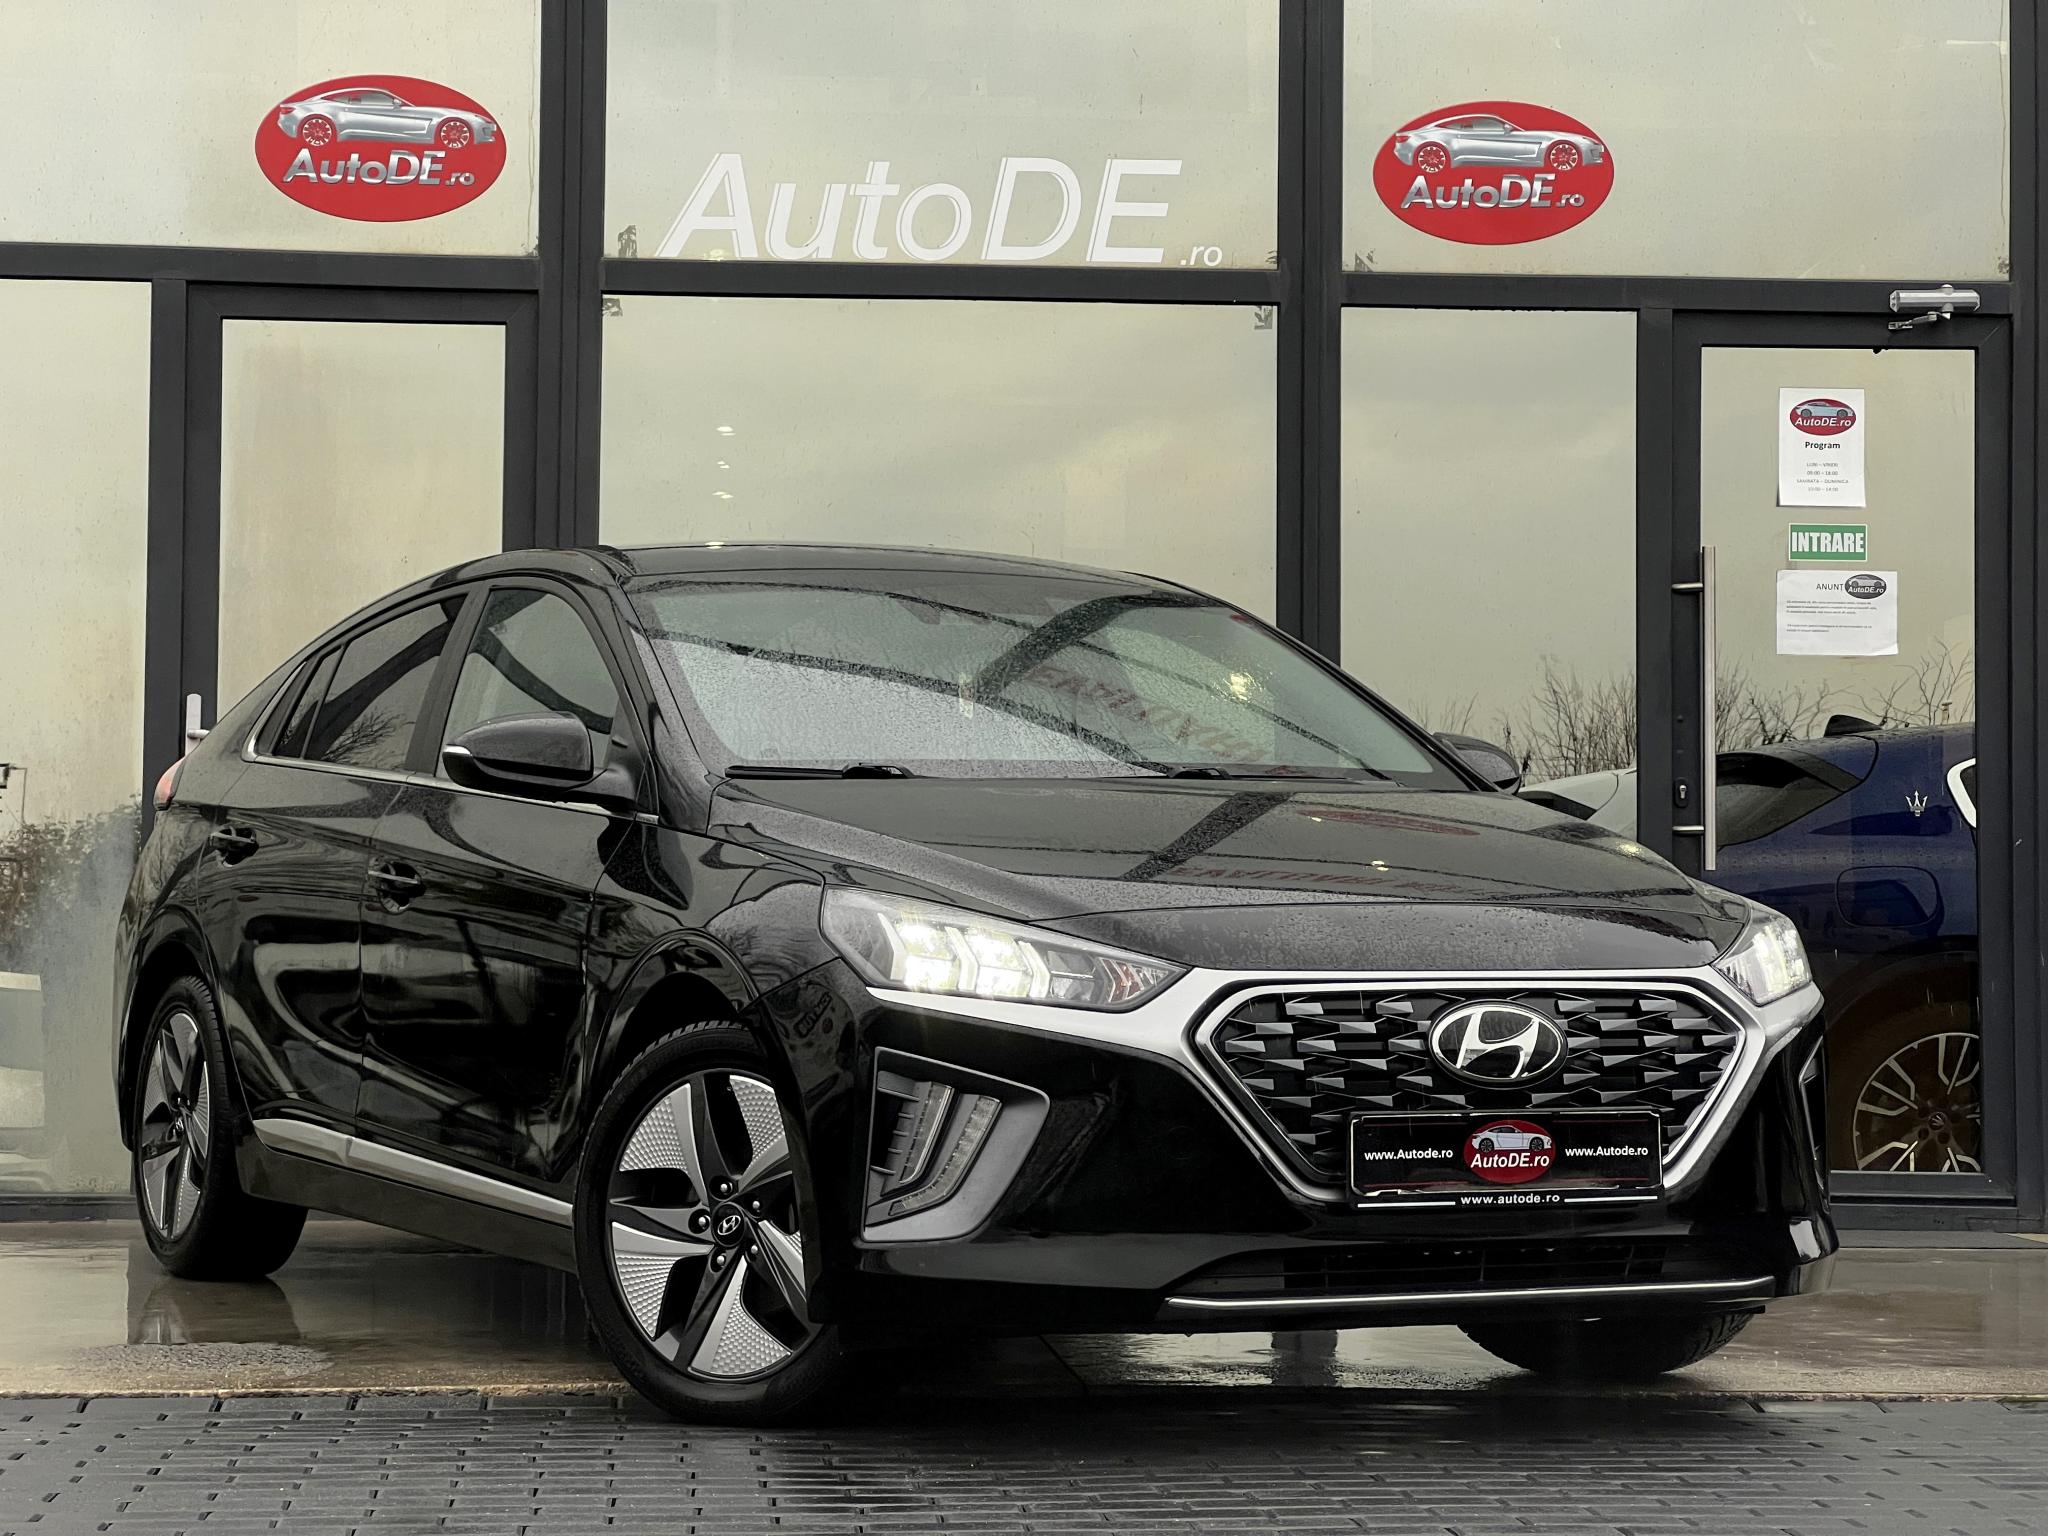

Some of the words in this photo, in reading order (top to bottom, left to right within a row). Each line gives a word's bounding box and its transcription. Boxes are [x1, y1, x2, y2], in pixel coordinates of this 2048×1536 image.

[1794, 417, 1852, 427] AutoDE.ro
[1804, 441, 1841, 450] Program
[1791, 531, 1865, 553] INTRARE
[1815, 583, 1844, 591] ANUNT
[1364, 1148, 1453, 1161] www.Autode.ro
[1470, 1152, 1550, 1169] AutoDE.ro
[1565, 1145, 1649, 1157] www.Autode.ro
[1460, 1192, 1560, 1205] www.autode.ro
